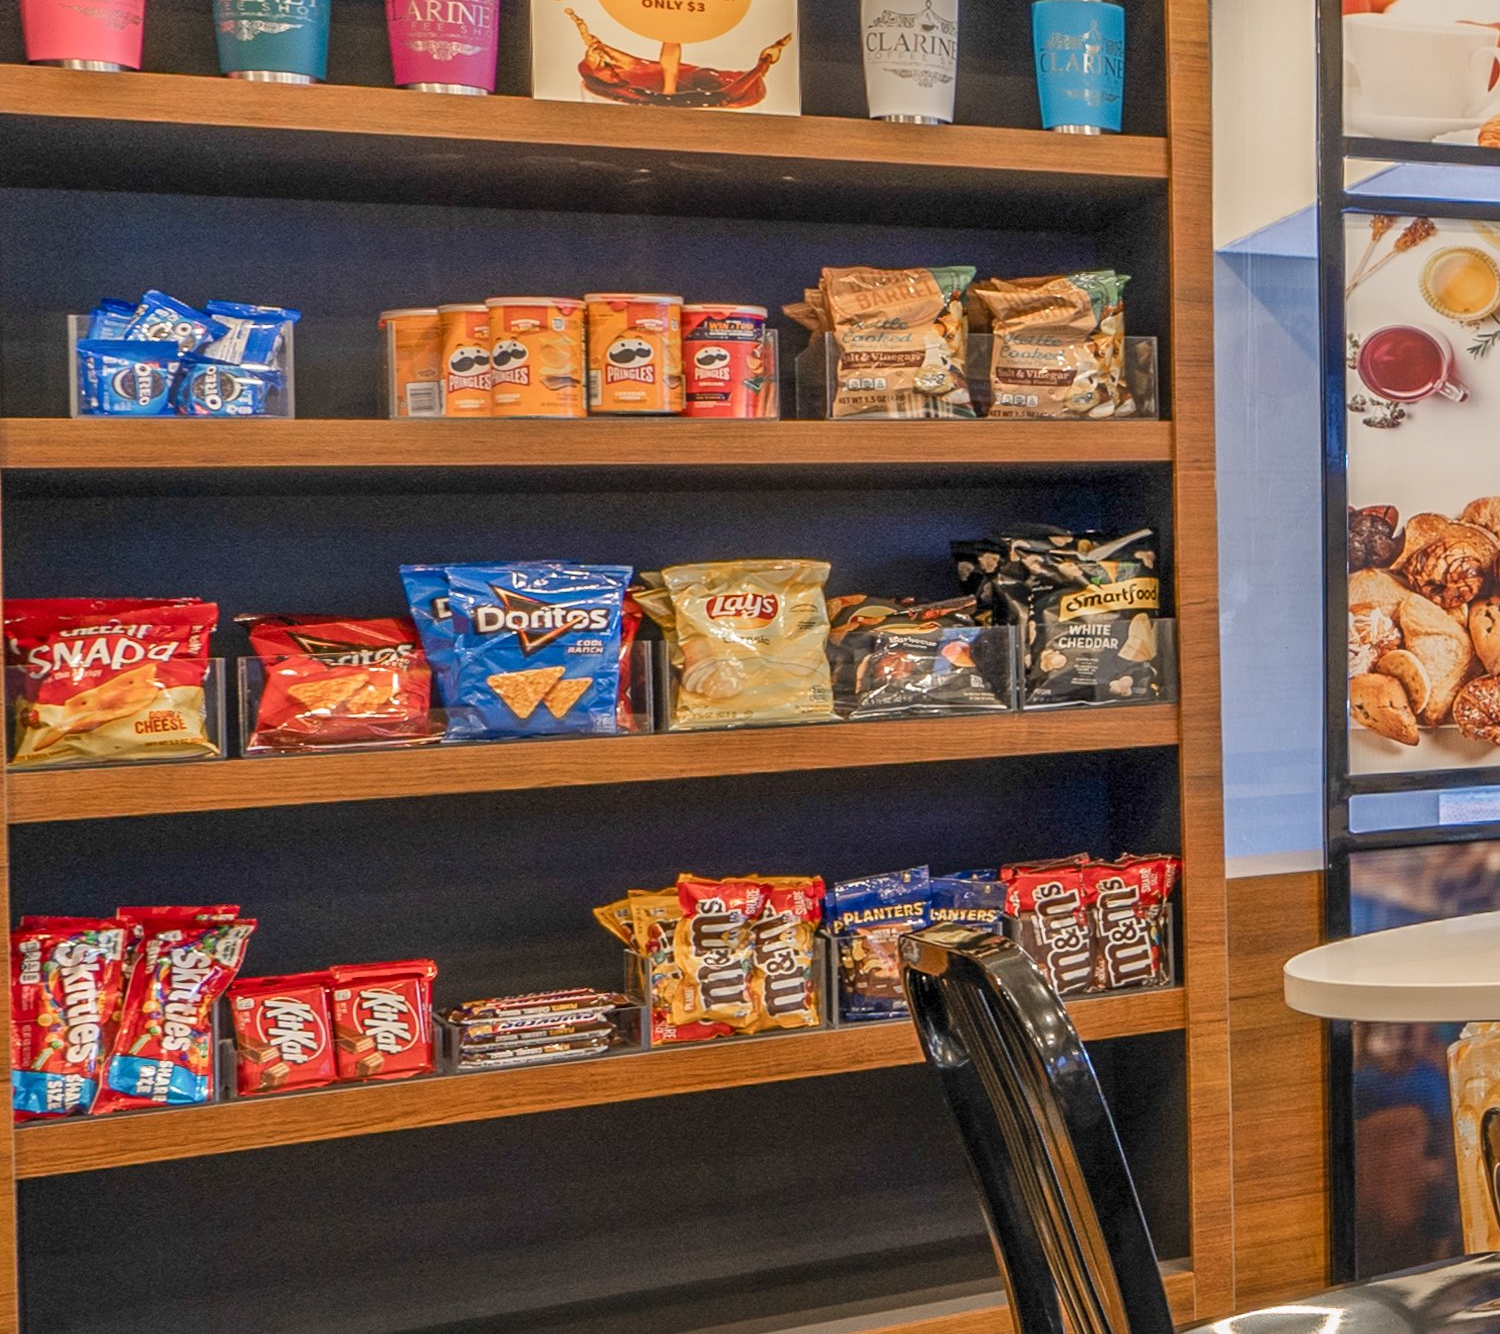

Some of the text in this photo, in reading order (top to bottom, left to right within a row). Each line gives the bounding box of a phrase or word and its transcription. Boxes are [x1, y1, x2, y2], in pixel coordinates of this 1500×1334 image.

[687, 1, 706, 13] $3
[607, 366, 654, 382] PRINGLES
[694, 366, 730, 380] PRINGLES
[1028, 370, 1070, 382] Vinegar
[135, 364, 150, 406] OREO
[205, 366, 223, 411] OREO
[1066, 584, 1157, 612] Smartfood
[708, 594, 775, 620] Lay's
[475, 604, 609, 634] Doritos
[1069, 624, 1111, 636] WHITE
[568, 646, 605, 654] RANCH
[1058, 636, 1119, 650] CHEDDAR
[134, 719, 188, 734] CHEESE
[844, 903, 925, 924] PLANTERS
[54, 944, 100, 1064] Skittles
